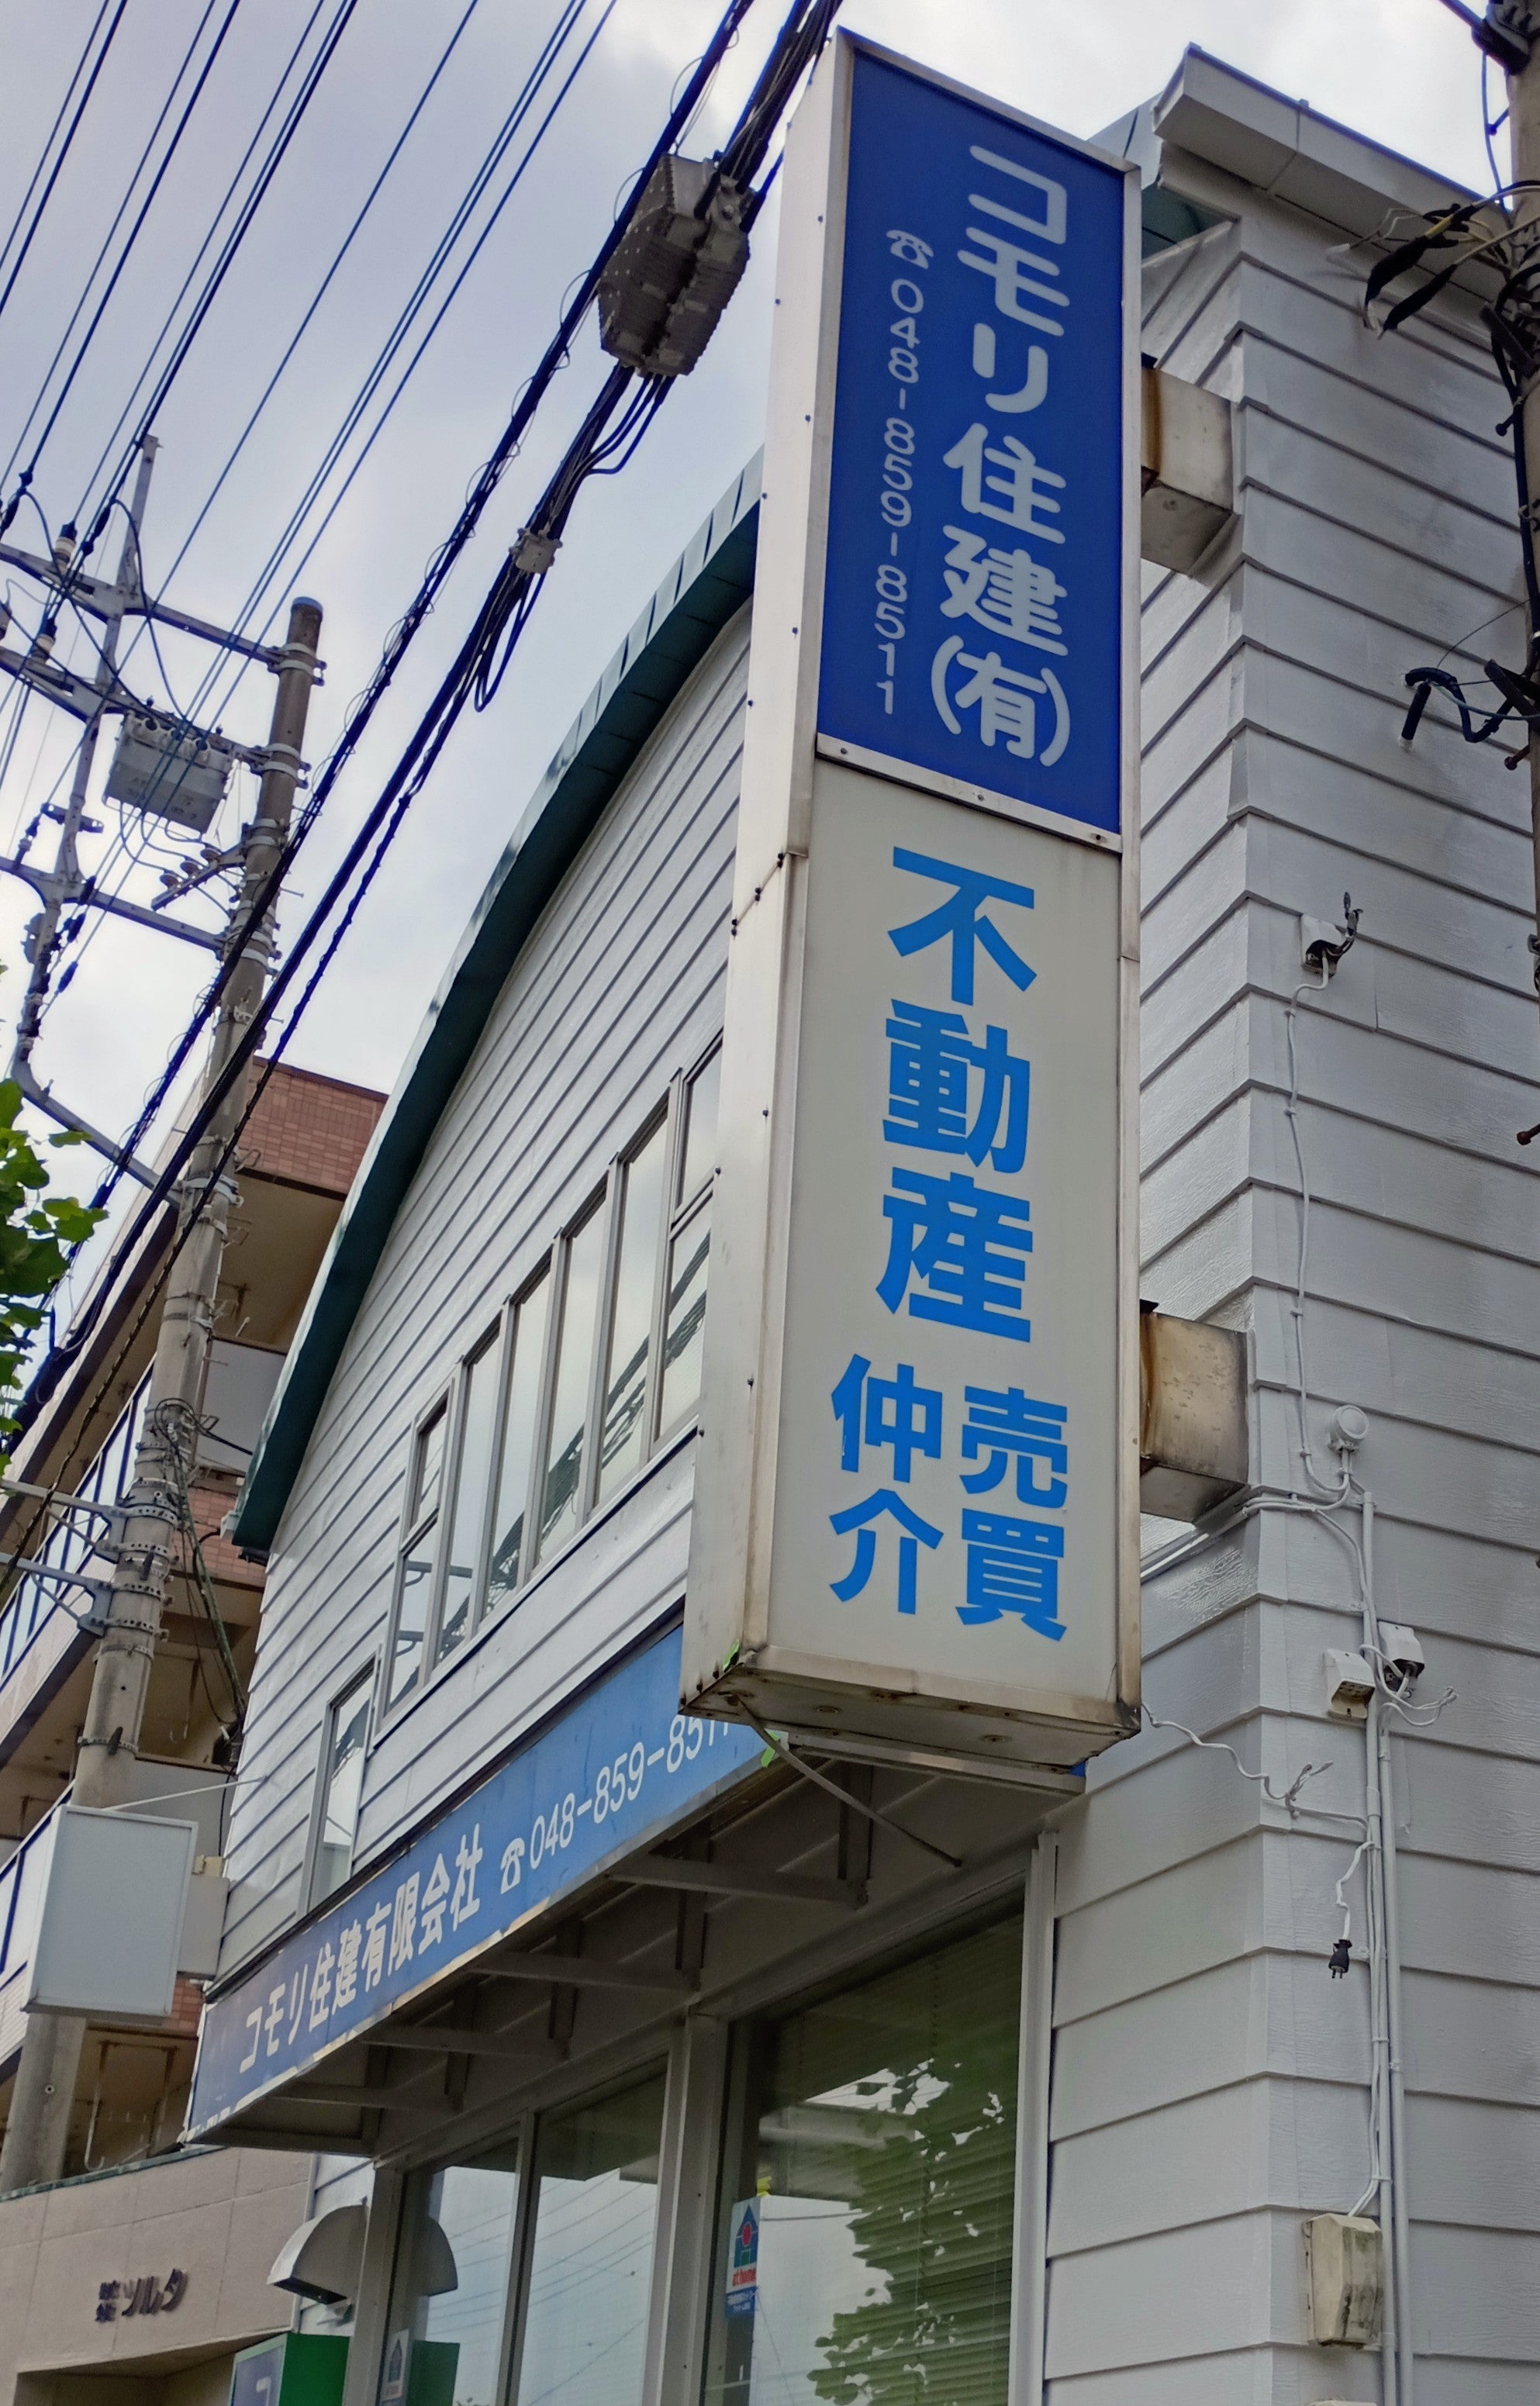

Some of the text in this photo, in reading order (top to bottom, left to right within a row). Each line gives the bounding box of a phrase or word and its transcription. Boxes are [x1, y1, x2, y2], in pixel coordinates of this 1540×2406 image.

[874, 278, 924, 714] 048-859-8511
[931, 144, 1070, 767] コモリ住建(有)
[875, 847, 1037, 1343] 不動産
[828, 1353, 944, 1616] 仲介
[955, 1386, 1068, 1642] 売買
[239, 1823, 484, 2074] コモリ住建有限会社
